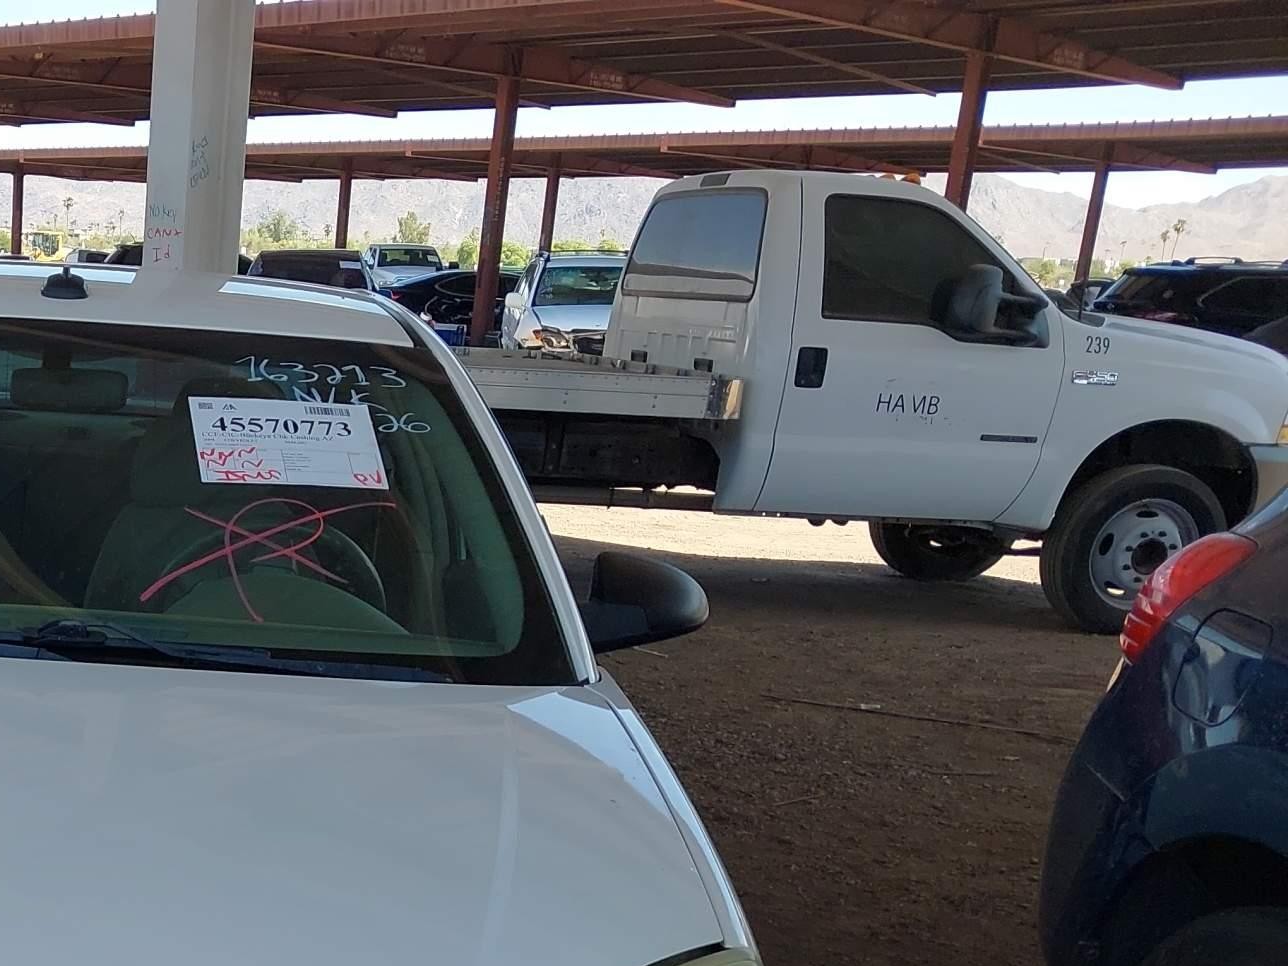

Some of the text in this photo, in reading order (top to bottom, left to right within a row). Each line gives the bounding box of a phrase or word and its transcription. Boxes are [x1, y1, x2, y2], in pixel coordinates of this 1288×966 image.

[1085, 335, 1111, 354] 239
[212, 416, 352, 437] 45570773
[376, 412, 431, 433] 26
